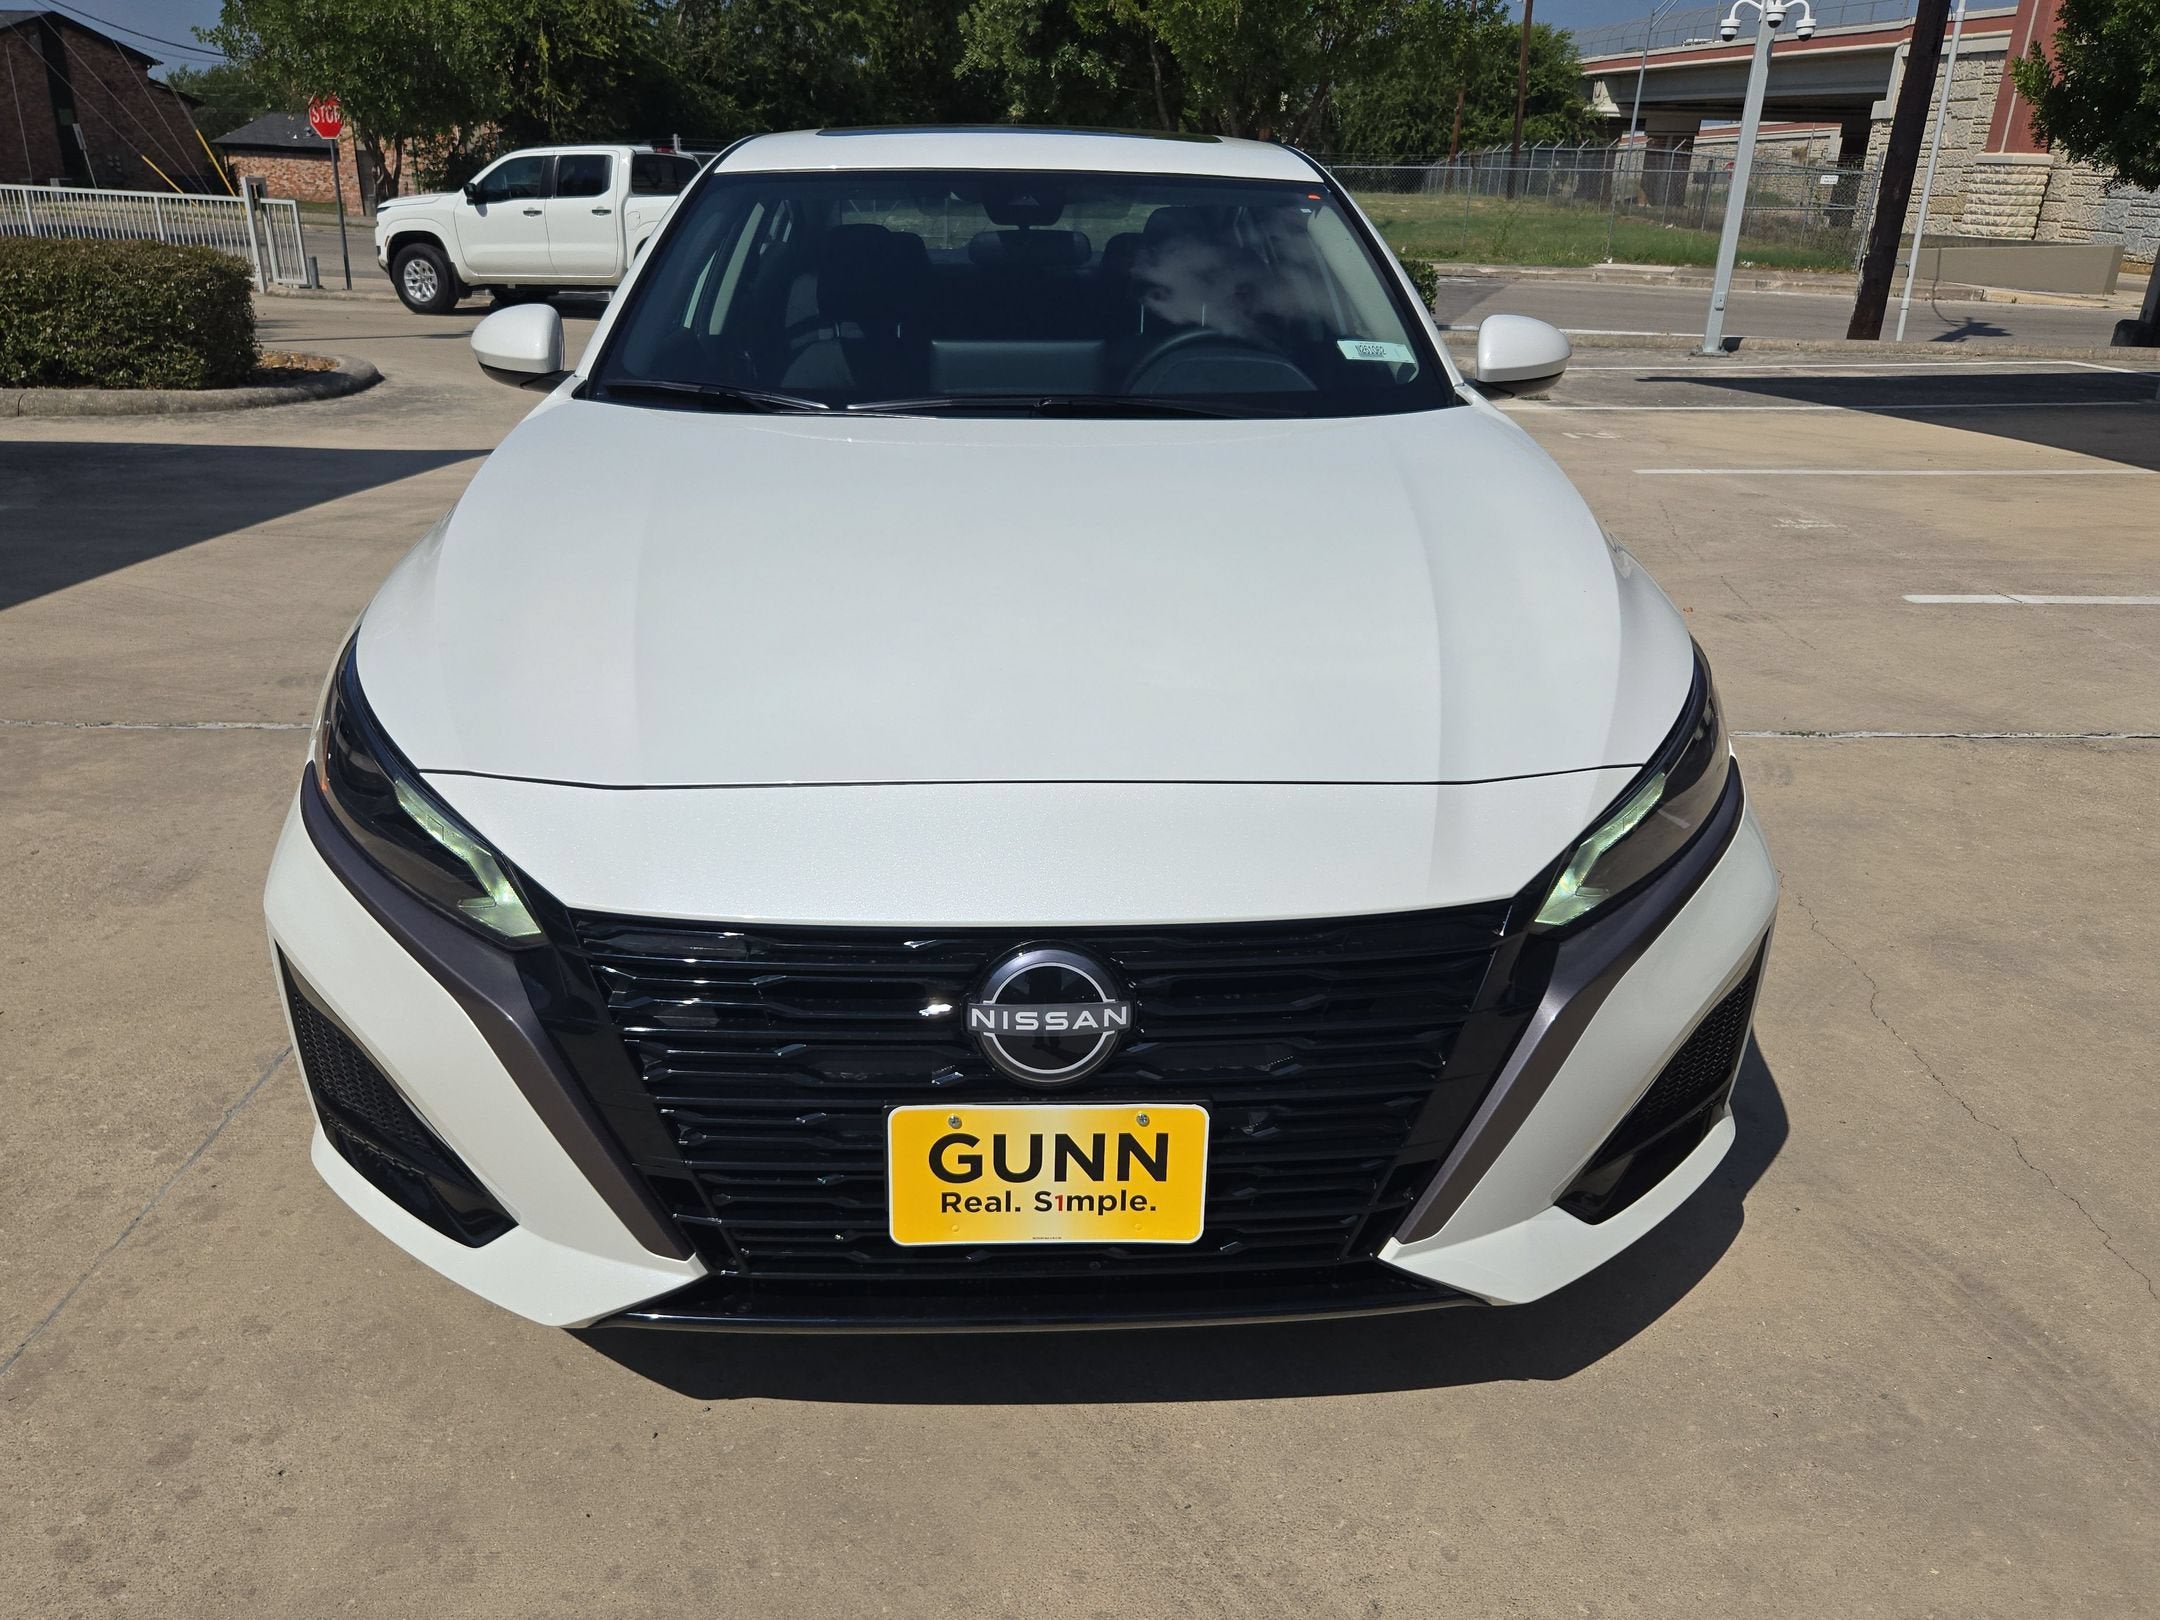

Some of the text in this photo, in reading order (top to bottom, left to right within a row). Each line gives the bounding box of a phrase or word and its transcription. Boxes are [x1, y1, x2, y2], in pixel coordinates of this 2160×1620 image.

[312, 105, 342, 124] STOP
[971, 1006, 1128, 1031] NISSAN
[928, 1132, 1169, 1184] GUNN
[941, 1189, 1157, 1216] Real. S1mple.
